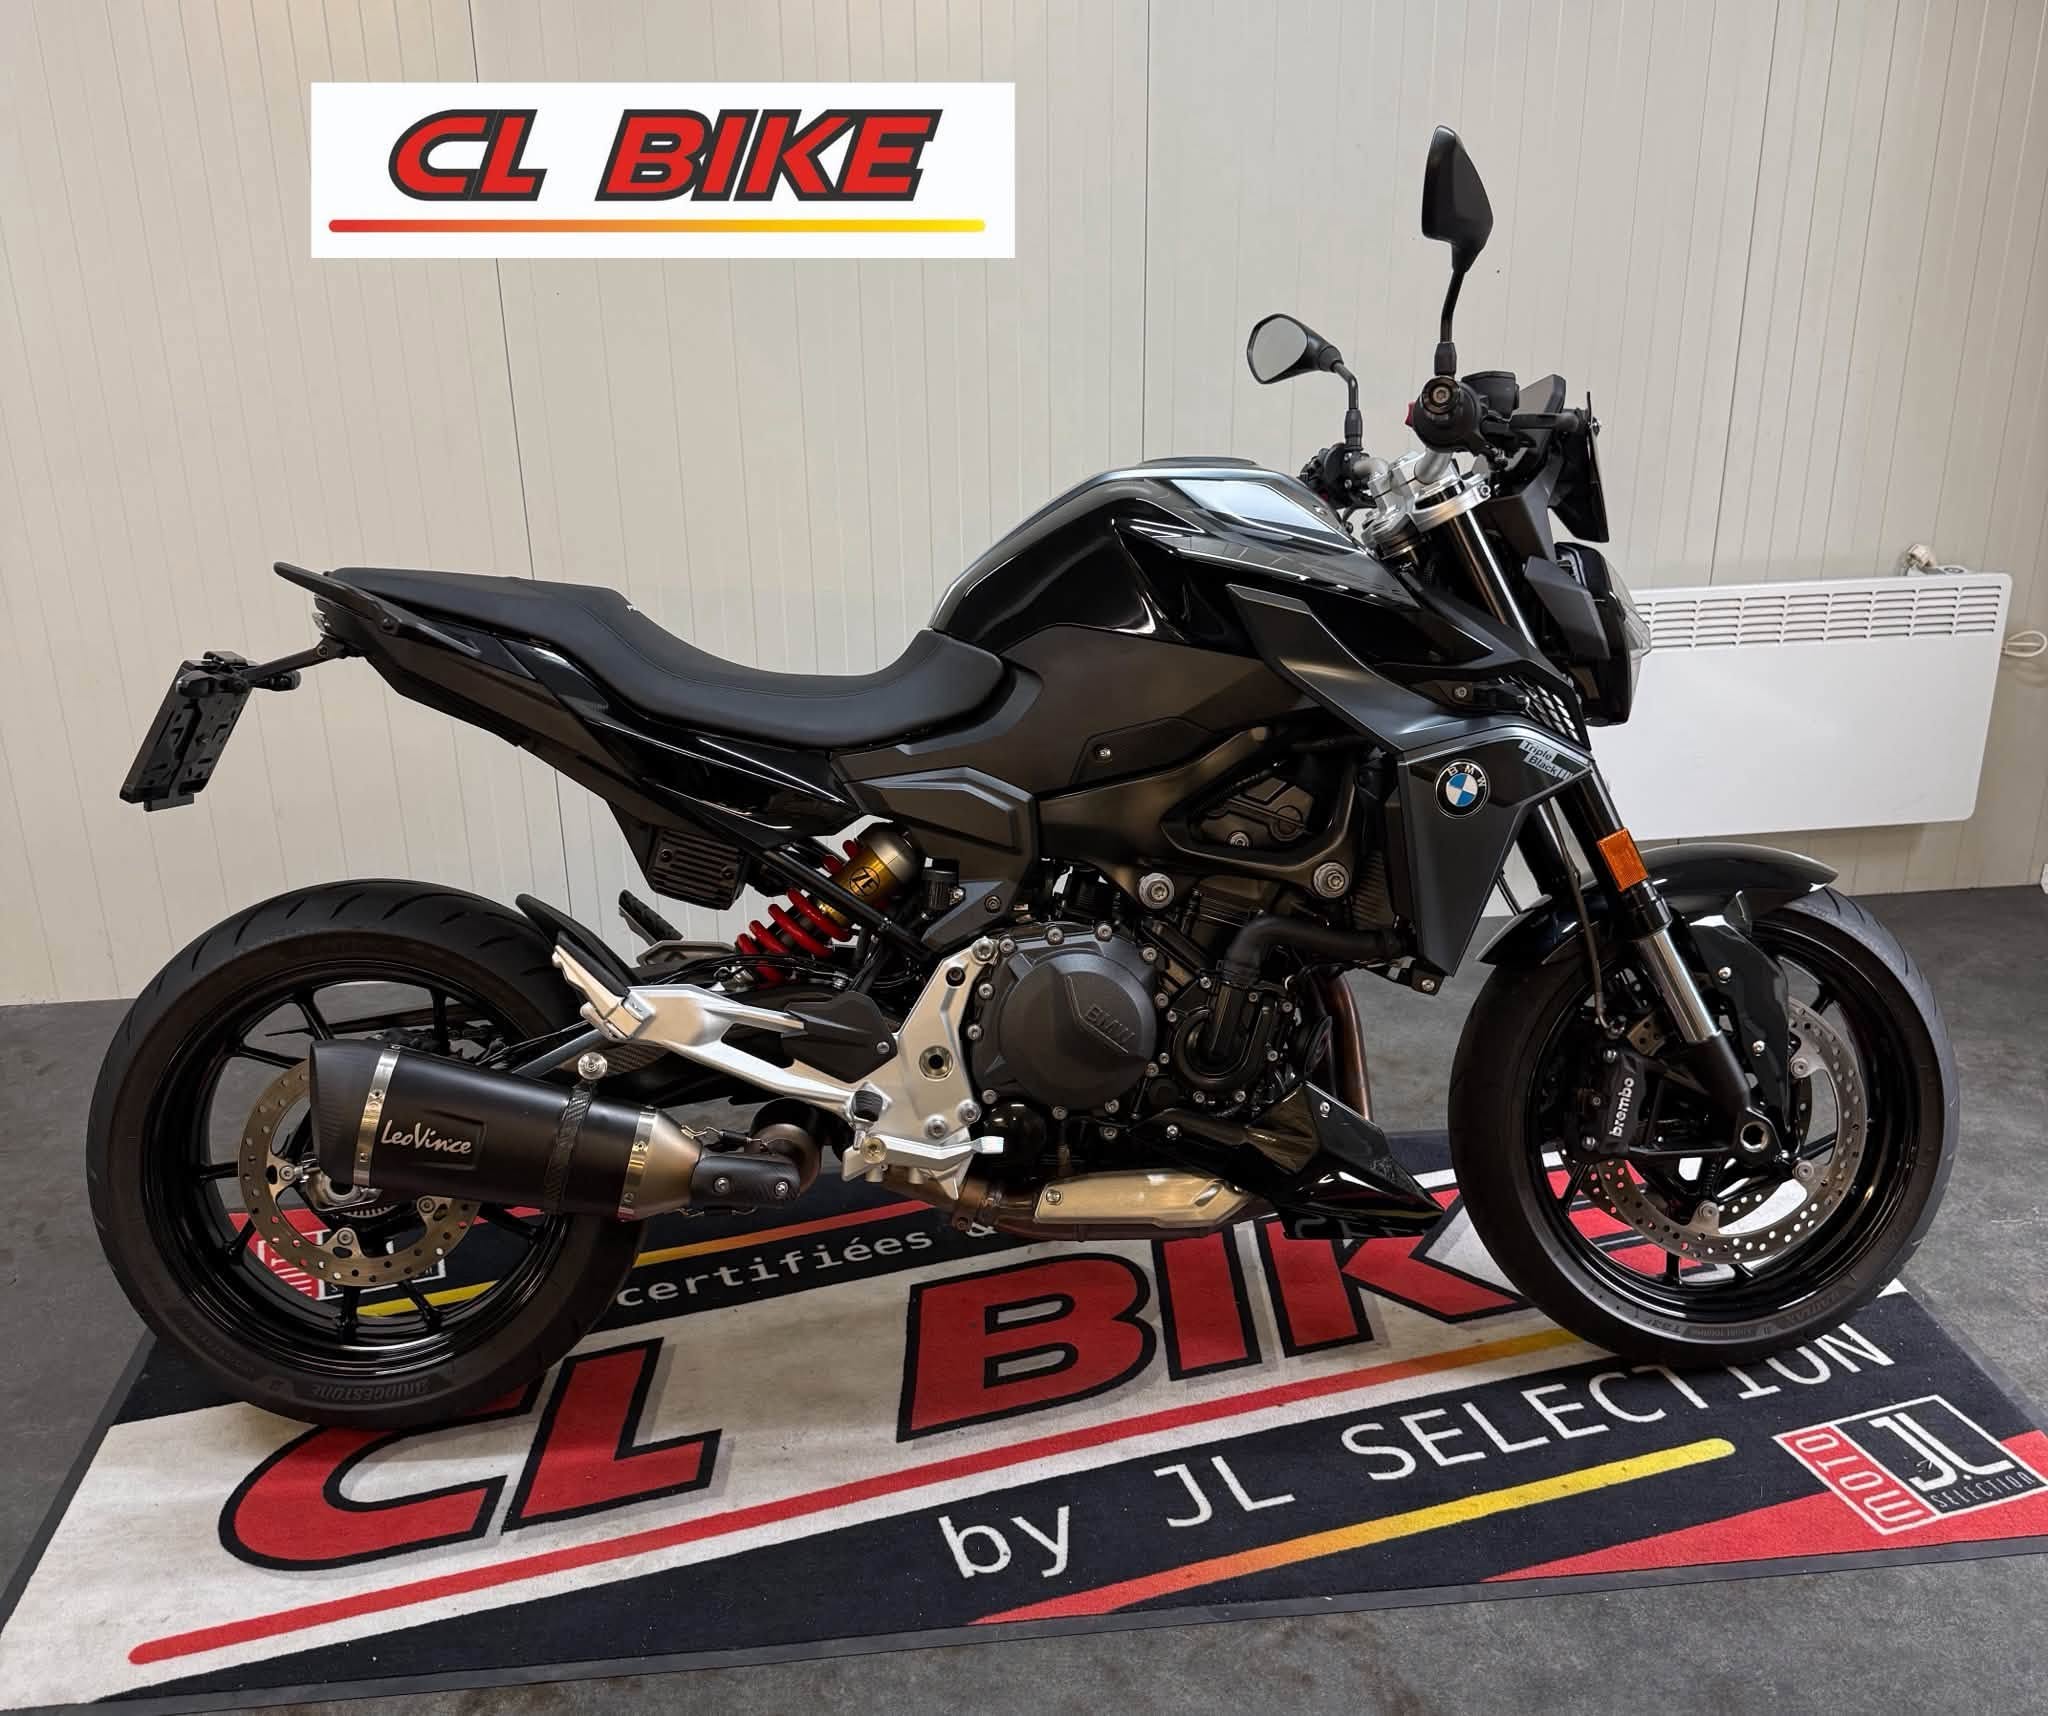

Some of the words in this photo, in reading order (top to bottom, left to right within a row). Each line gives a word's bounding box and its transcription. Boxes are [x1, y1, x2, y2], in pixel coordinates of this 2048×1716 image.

[1523, 741, 1552, 760] Triple
[1528, 755, 1558, 776] Black
[1086, 1004, 1136, 1044] BMW
[1608, 1077, 1635, 1137] brembo
[380, 1119, 473, 1155] LeoVince
[615, 1229, 934, 1308] certifiées
[311, 1377, 433, 1401] BRIDGESTONE
[218, 1336, 722, 1571] CL
[1795, 1433, 1926, 1523] MOTO
[1930, 1470, 2037, 1509] SELECTION
[938, 1504, 1070, 1579] by
[1153, 1455, 1297, 1528] JL
